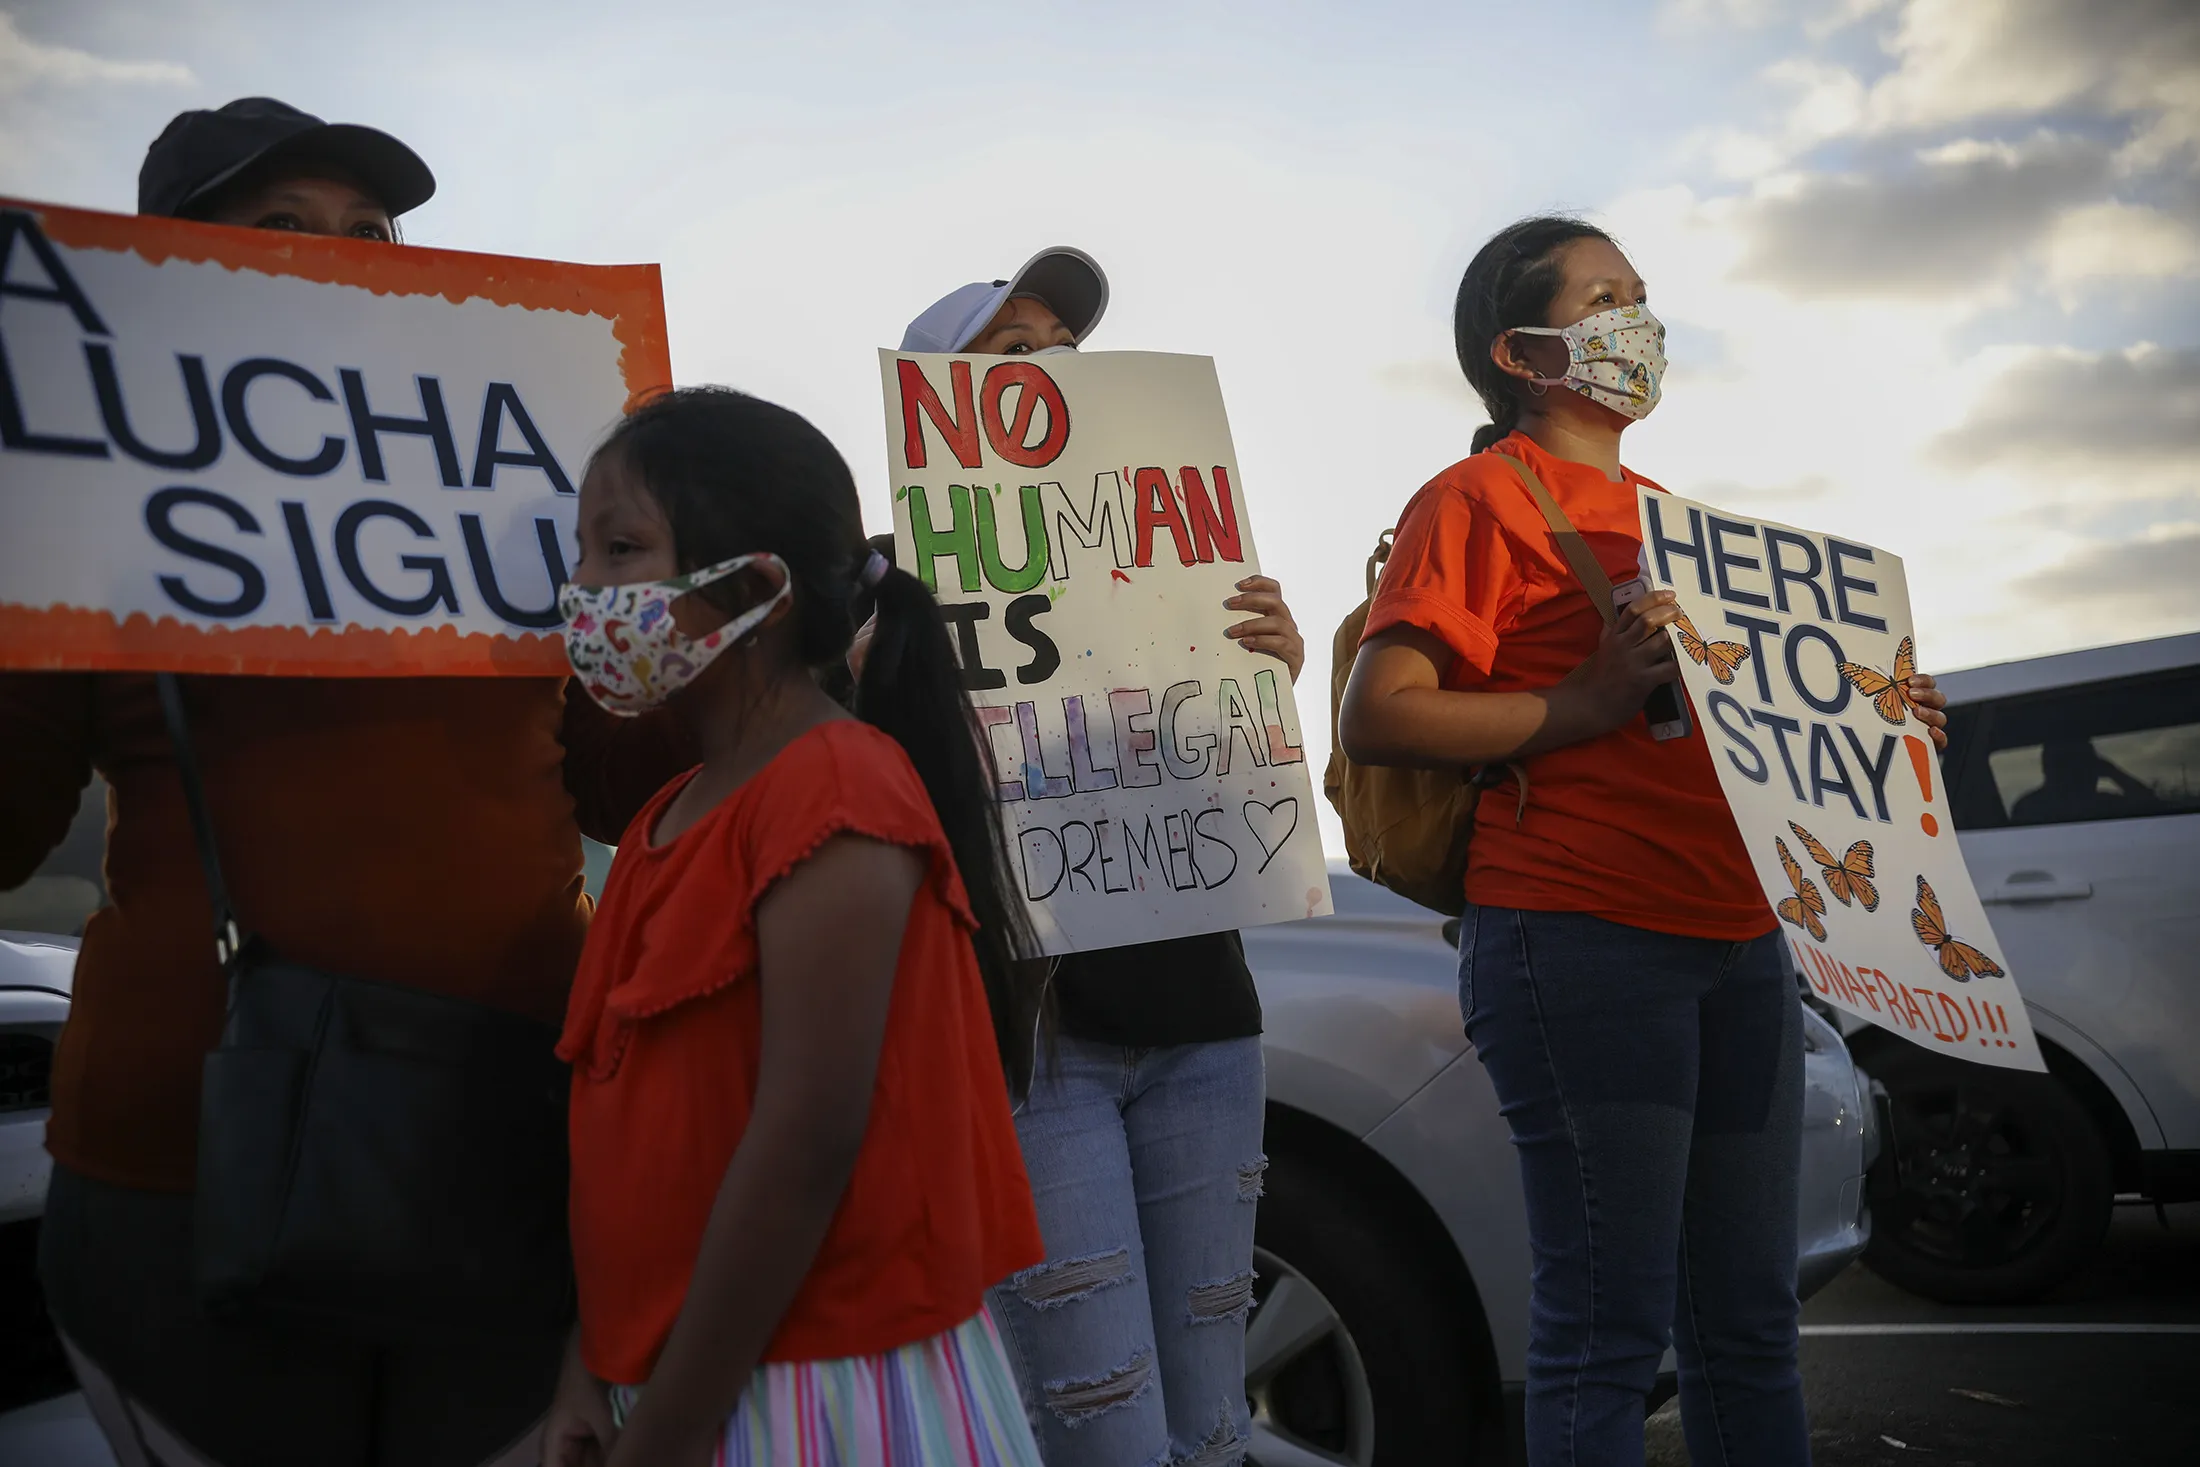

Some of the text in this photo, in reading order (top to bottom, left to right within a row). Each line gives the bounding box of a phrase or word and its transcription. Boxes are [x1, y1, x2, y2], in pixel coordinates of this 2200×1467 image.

[0, 208, 113, 336] A
[0, 334, 577, 495] LUCHA
[896, 359, 1071, 469] NO
[144, 486, 570, 629] SIGU
[906, 465, 1245, 593] HUMAN
[1644, 494, 1889, 634] HERE
[944, 594, 1061, 691] IS
[1724, 609, 1853, 716] TO
[974, 669, 1303, 802] ILLEGAL
[1792, 938, 2017, 1049] UNAFRAID!!!
